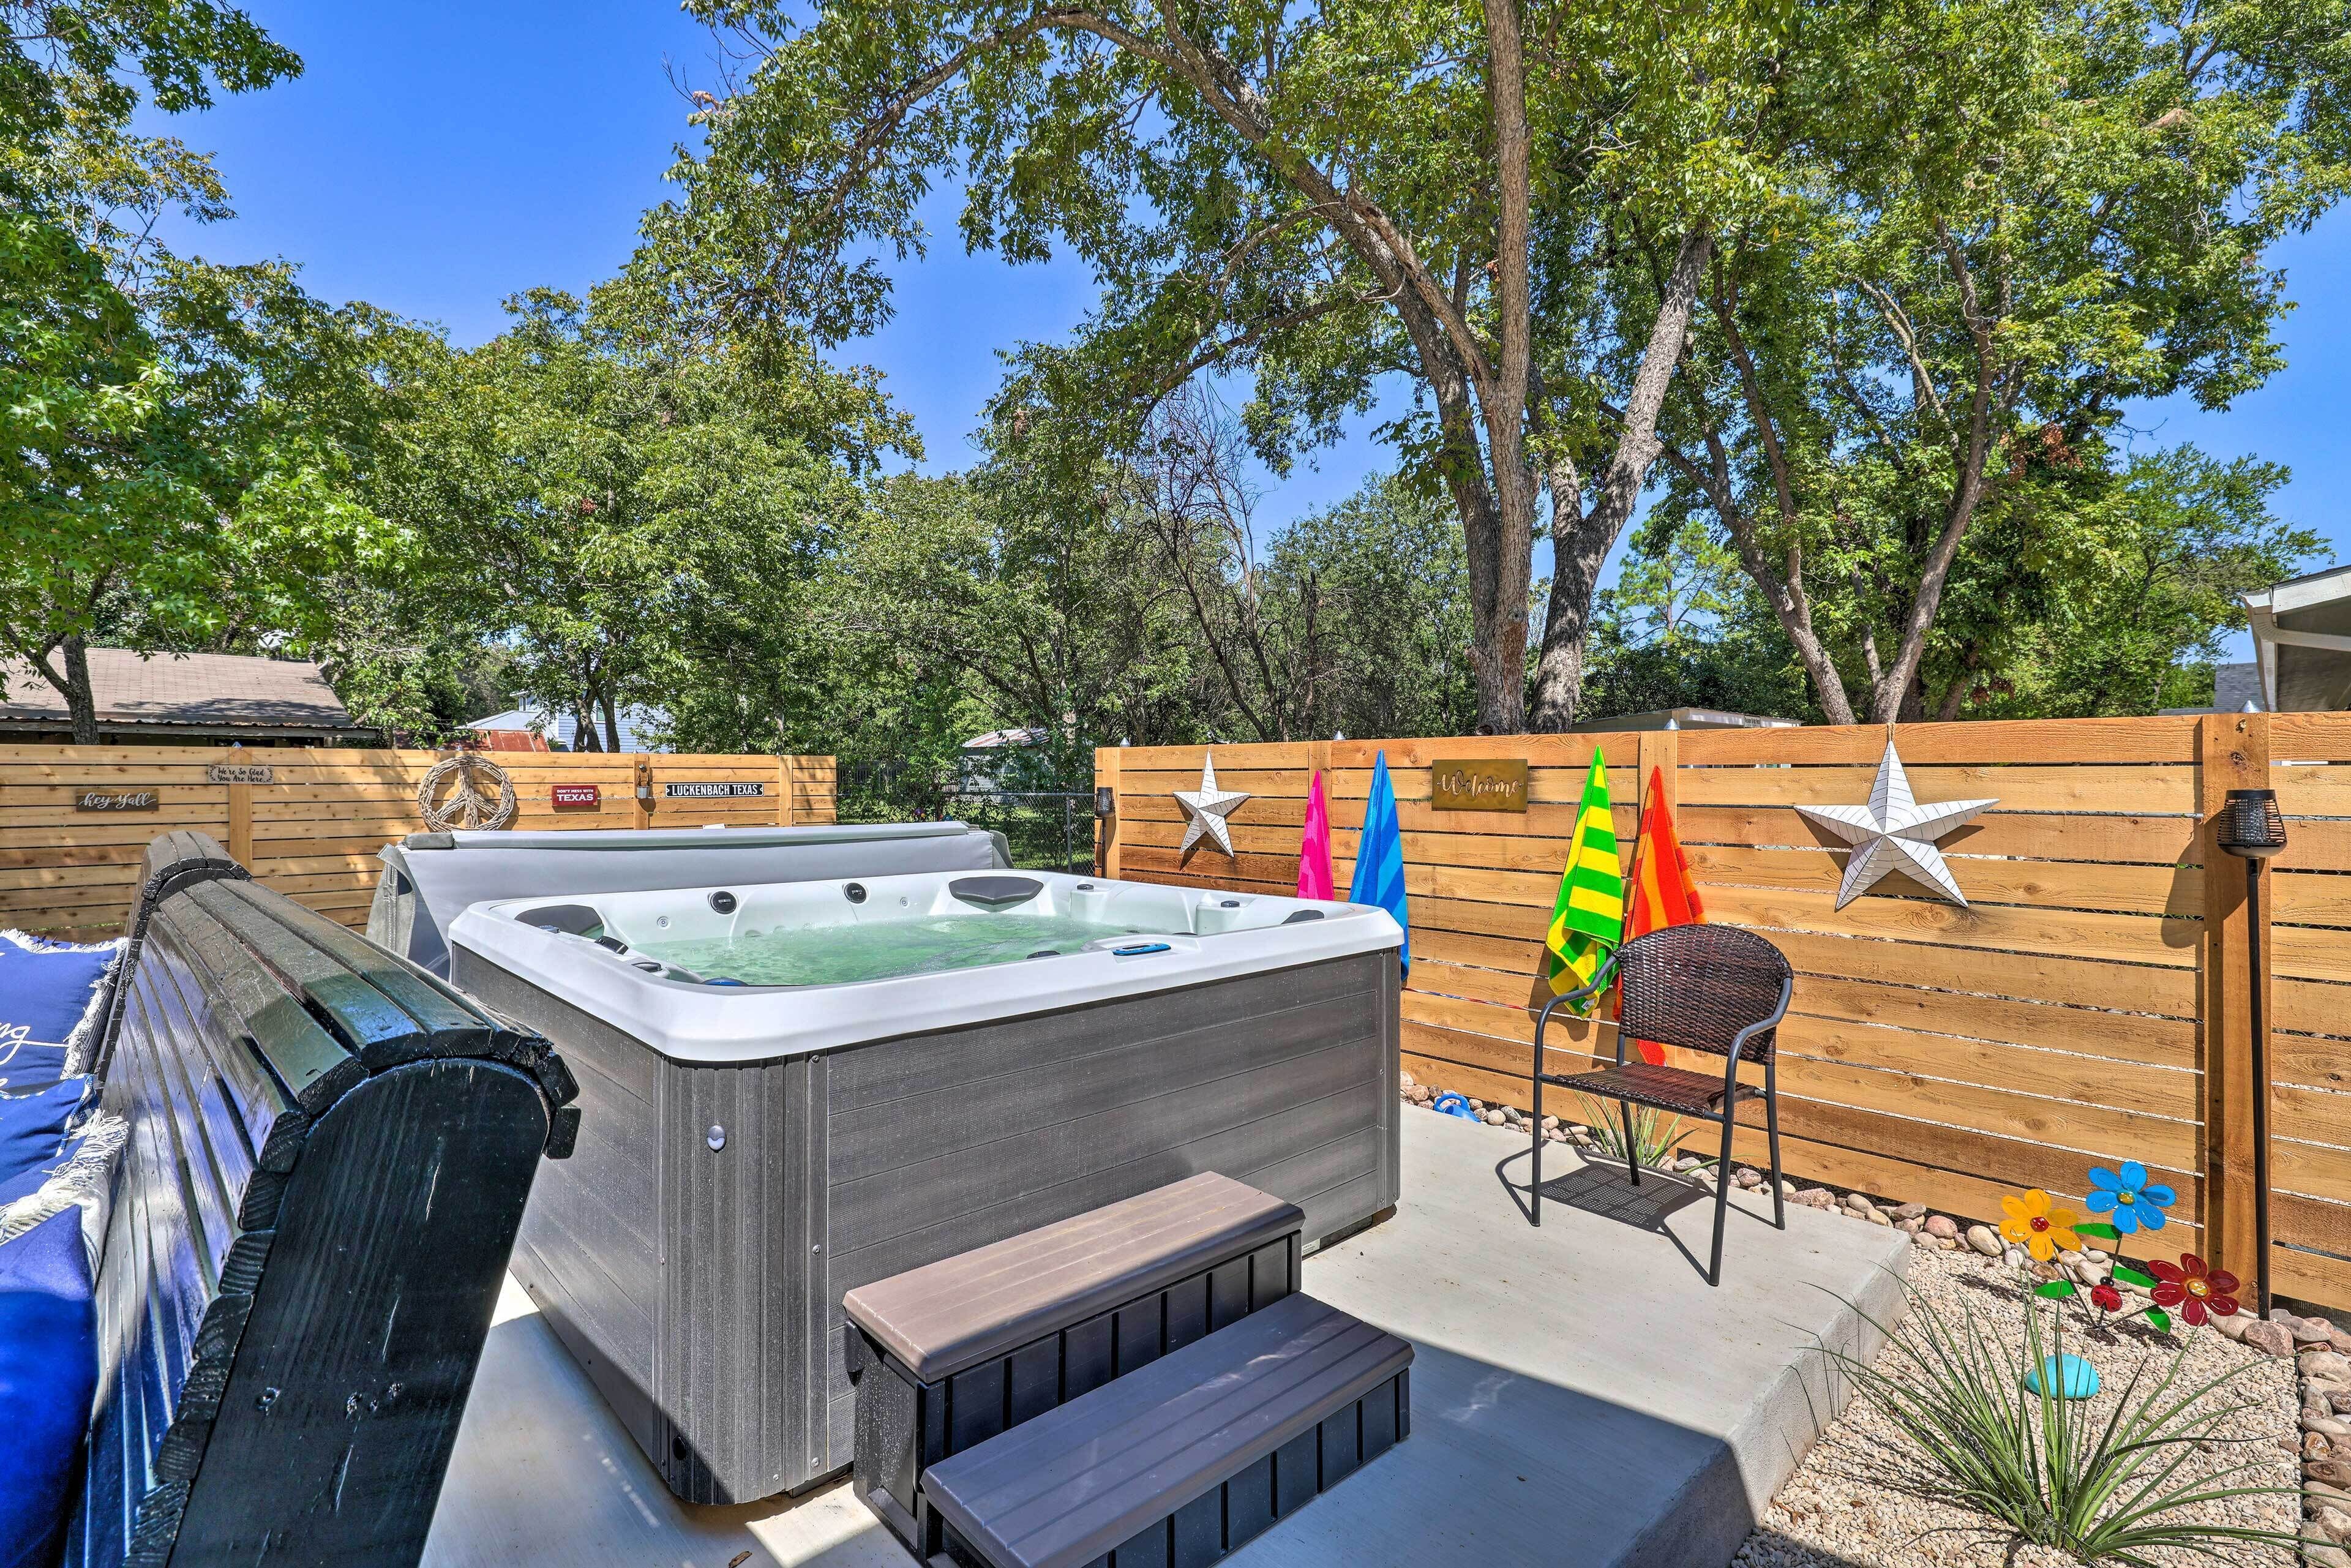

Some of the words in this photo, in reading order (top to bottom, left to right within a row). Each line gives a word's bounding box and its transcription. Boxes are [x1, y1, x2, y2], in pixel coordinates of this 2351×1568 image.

[218, 767, 236, 775] We're
[249, 768, 264, 776] Glad
[672, 784, 730, 796] LUCKENBACH
[732, 784, 758, 795] TEXAS
[1437, 769, 1524, 798] Welcome
[78, 792, 114, 809] hey
